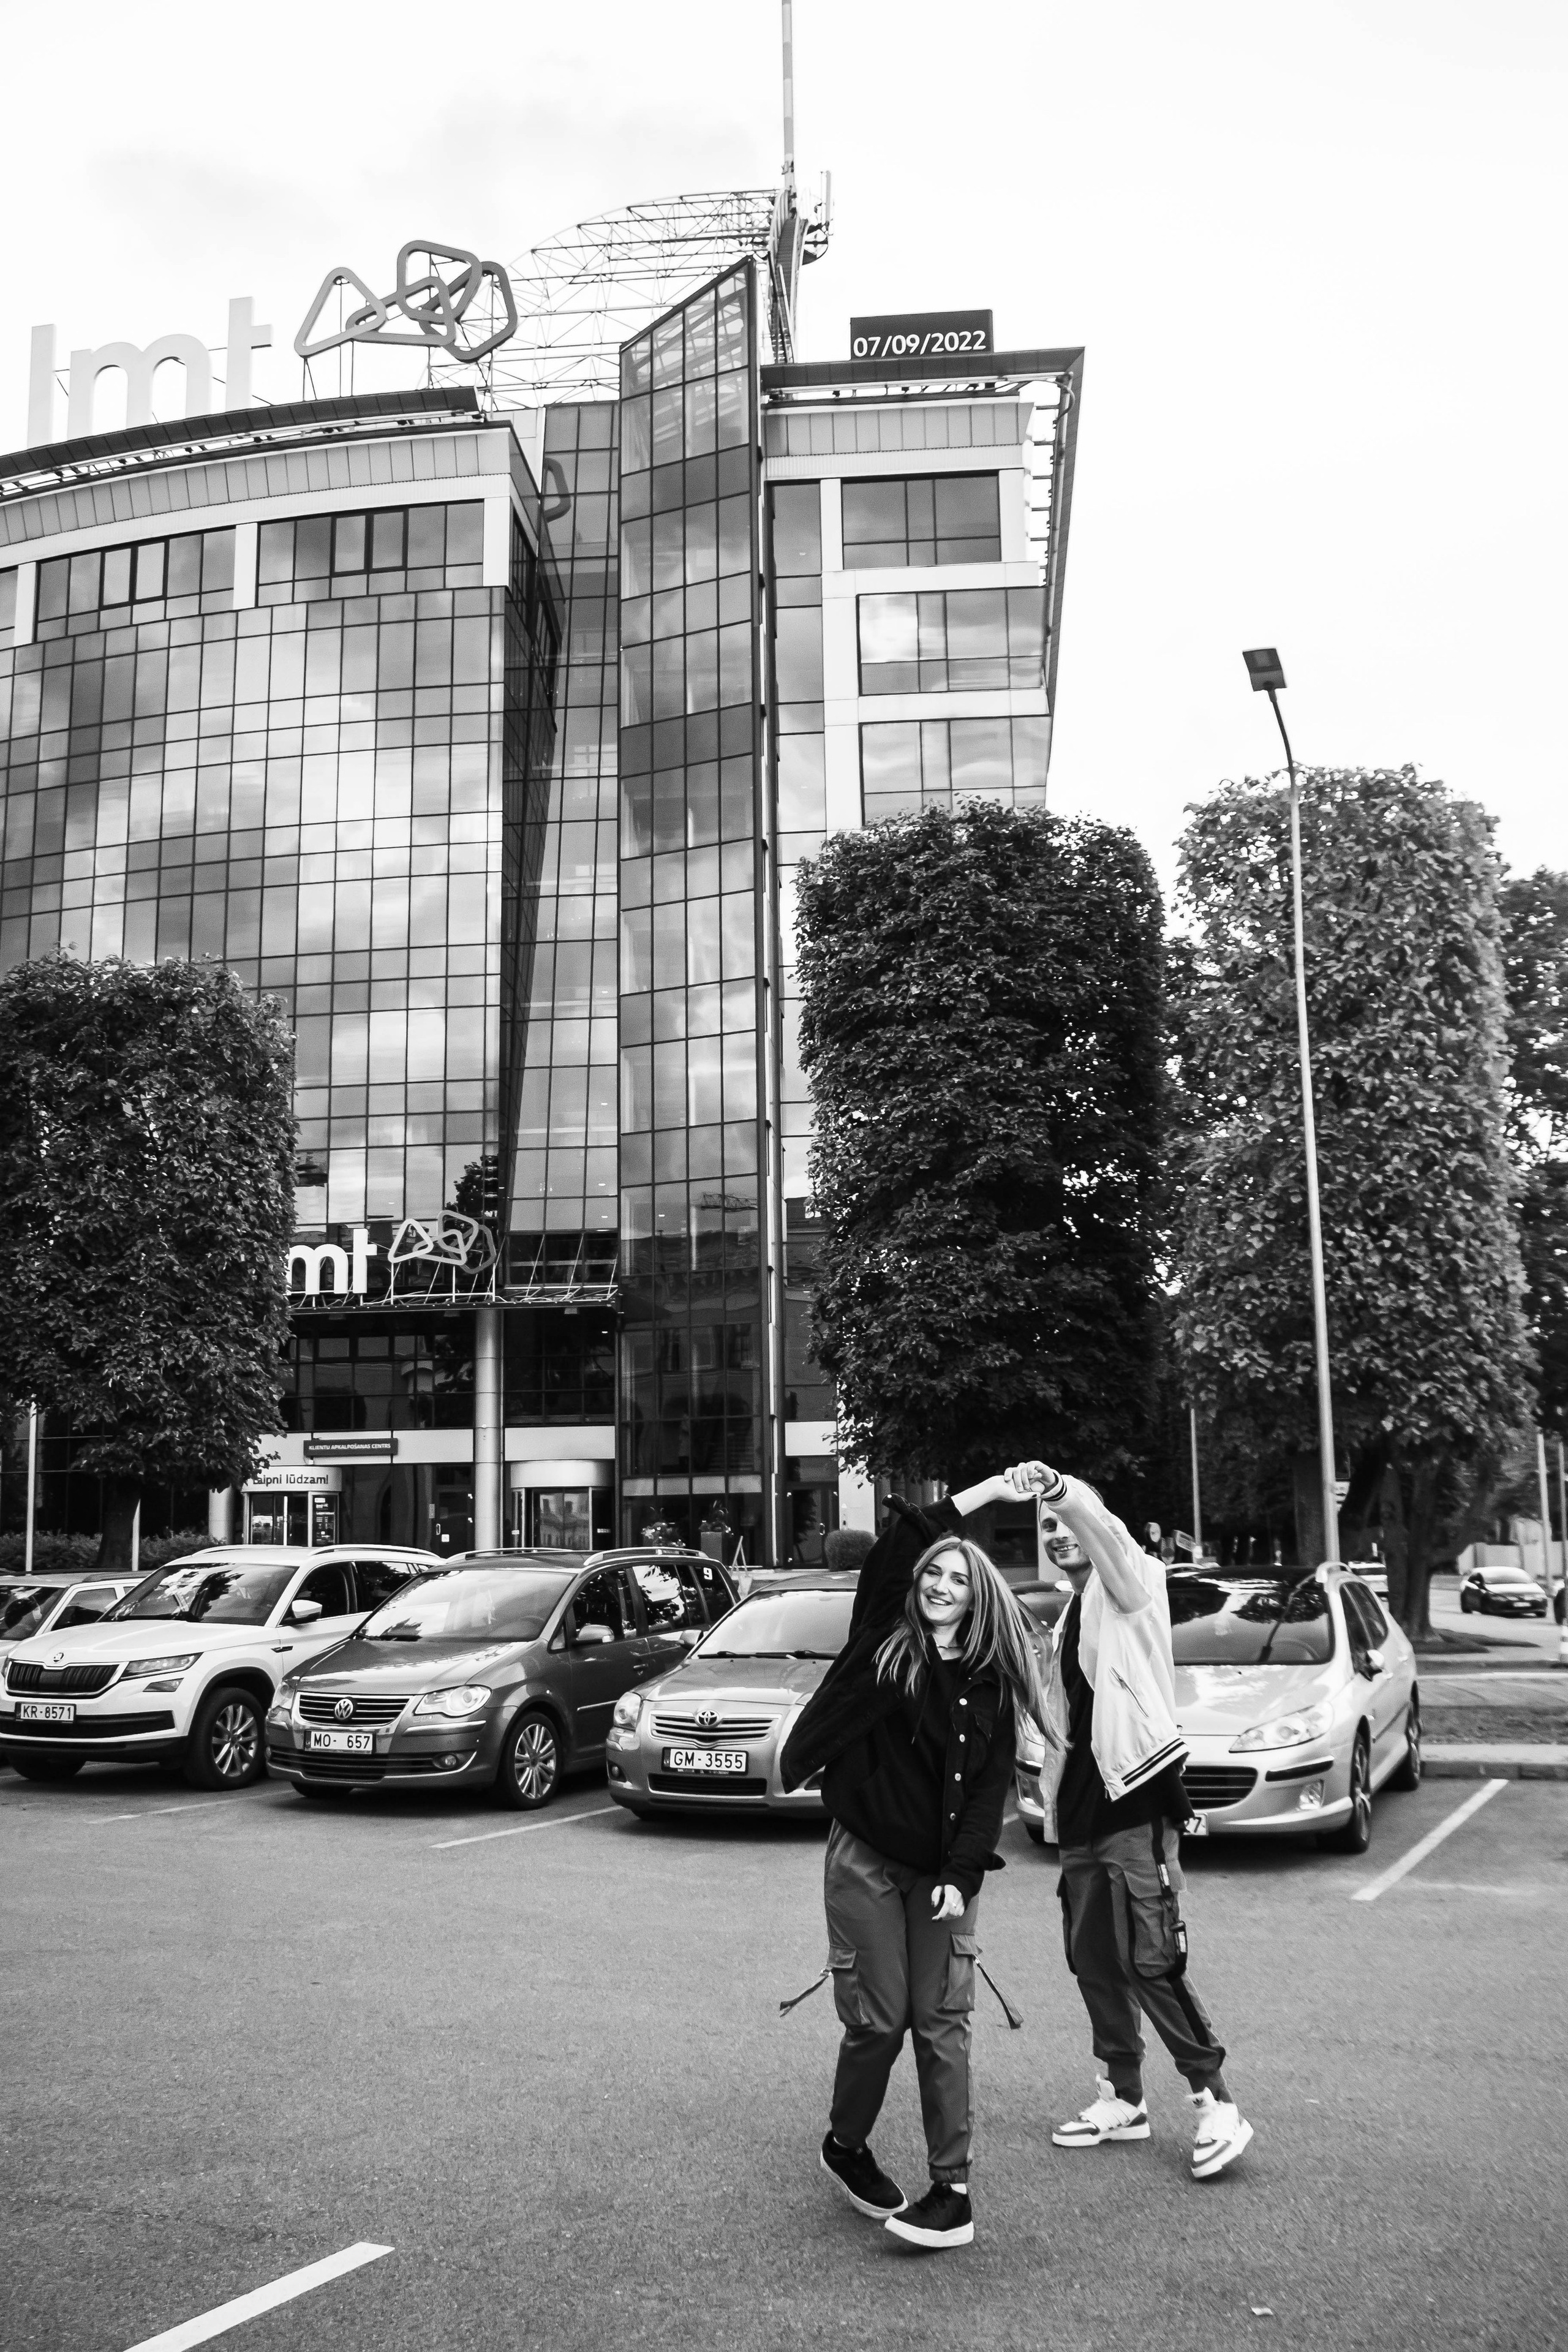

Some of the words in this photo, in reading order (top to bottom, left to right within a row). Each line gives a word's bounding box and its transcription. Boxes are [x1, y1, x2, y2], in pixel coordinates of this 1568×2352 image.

[853, 330, 986, 358] 07/09/2022
[27, 296, 272, 448] lmt
[285, 1229, 378, 1295] mt
[703, 1567, 712, 1580] 9
